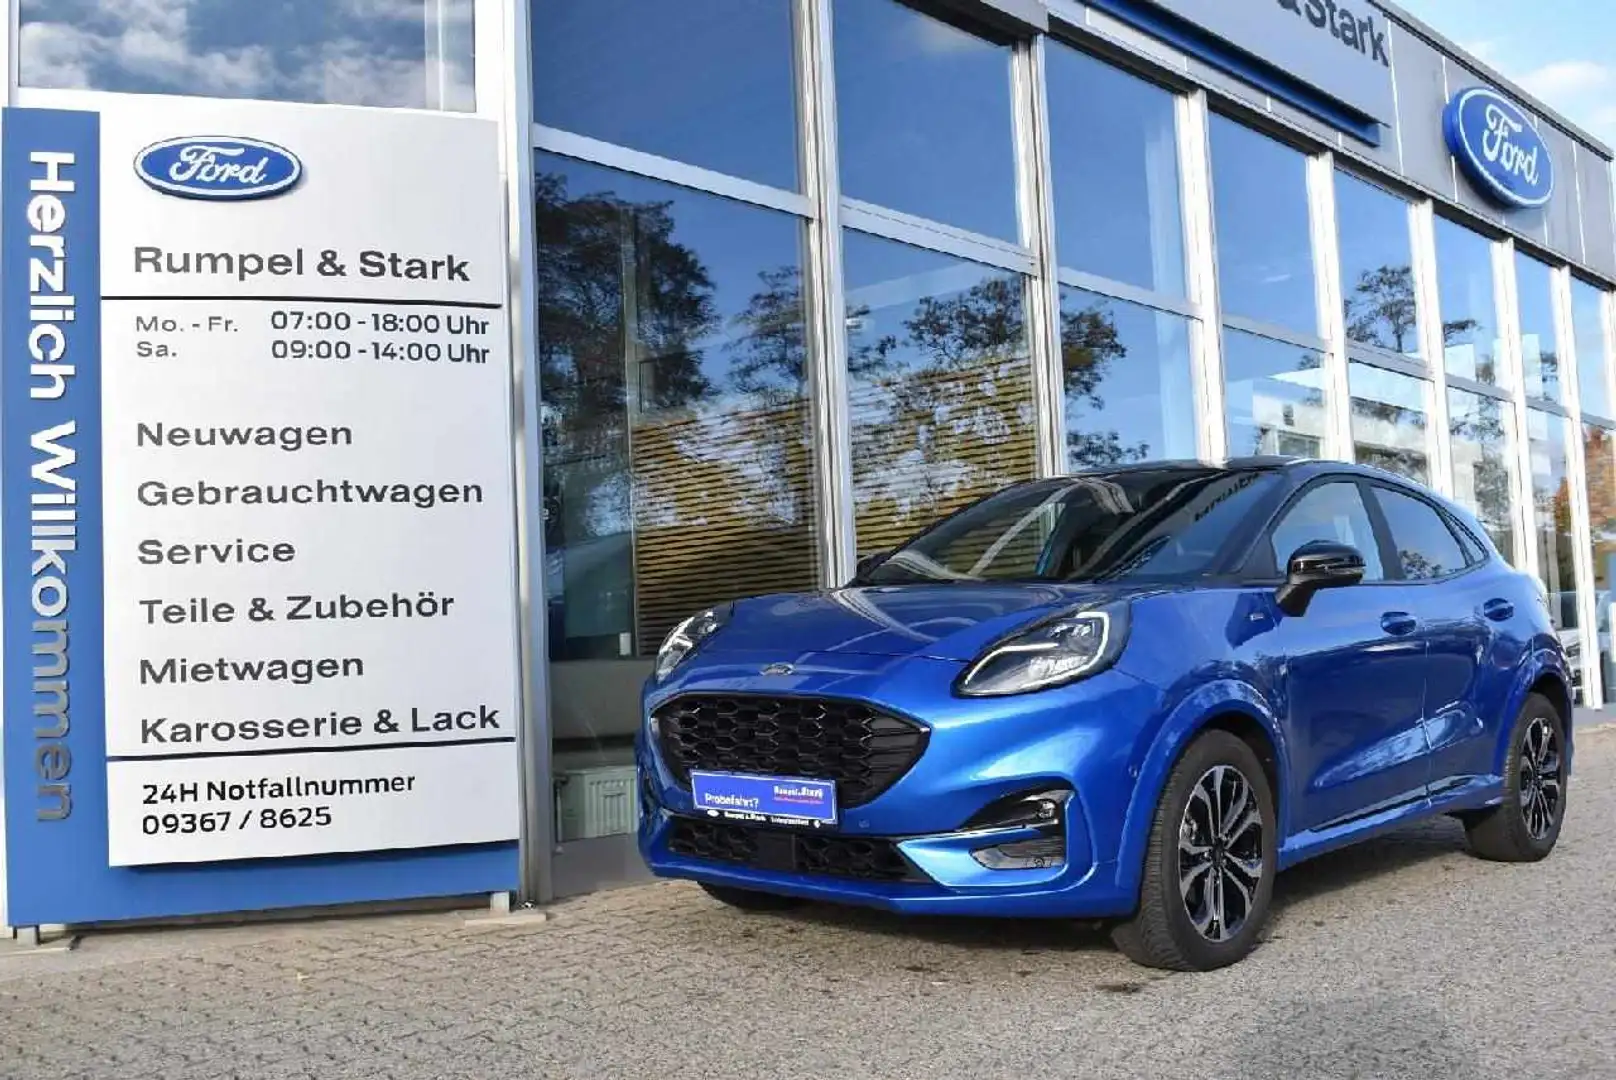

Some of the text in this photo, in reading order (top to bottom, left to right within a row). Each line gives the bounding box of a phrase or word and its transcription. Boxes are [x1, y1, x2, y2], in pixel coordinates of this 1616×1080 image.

[1482, 103, 1541, 187] Ford
[168, 144, 269, 185] Ford
[134, 246, 471, 282] Rumpel & Stark
[136, 315, 184, 333] Mo.
[208, 316, 239, 333] Fr.
[270, 310, 351, 331] 07:00
[371, 313, 441, 334] 18:00
[446, 314, 490, 335] Uhr
[136, 340, 177, 358] Sa.
[271, 340, 351, 360] 09:00
[371, 342, 442, 362] 14:00
[447, 343, 491, 364] Uhr
[137, 422, 353, 452] Neuwagen
[27, 151, 76, 822] Herzlich Willkommen
[137, 479, 484, 509] Gebrauchtwagen
[138, 538, 296, 565] Service
[139, 591, 455, 625] Teile & Zubehör
[139, 653, 364, 685] Mietwagen
[141, 704, 501, 744] Karosserie & Lack
[142, 774, 416, 805] 24H Notfallnummer
[142, 805, 332, 836] 09367 / 8625
